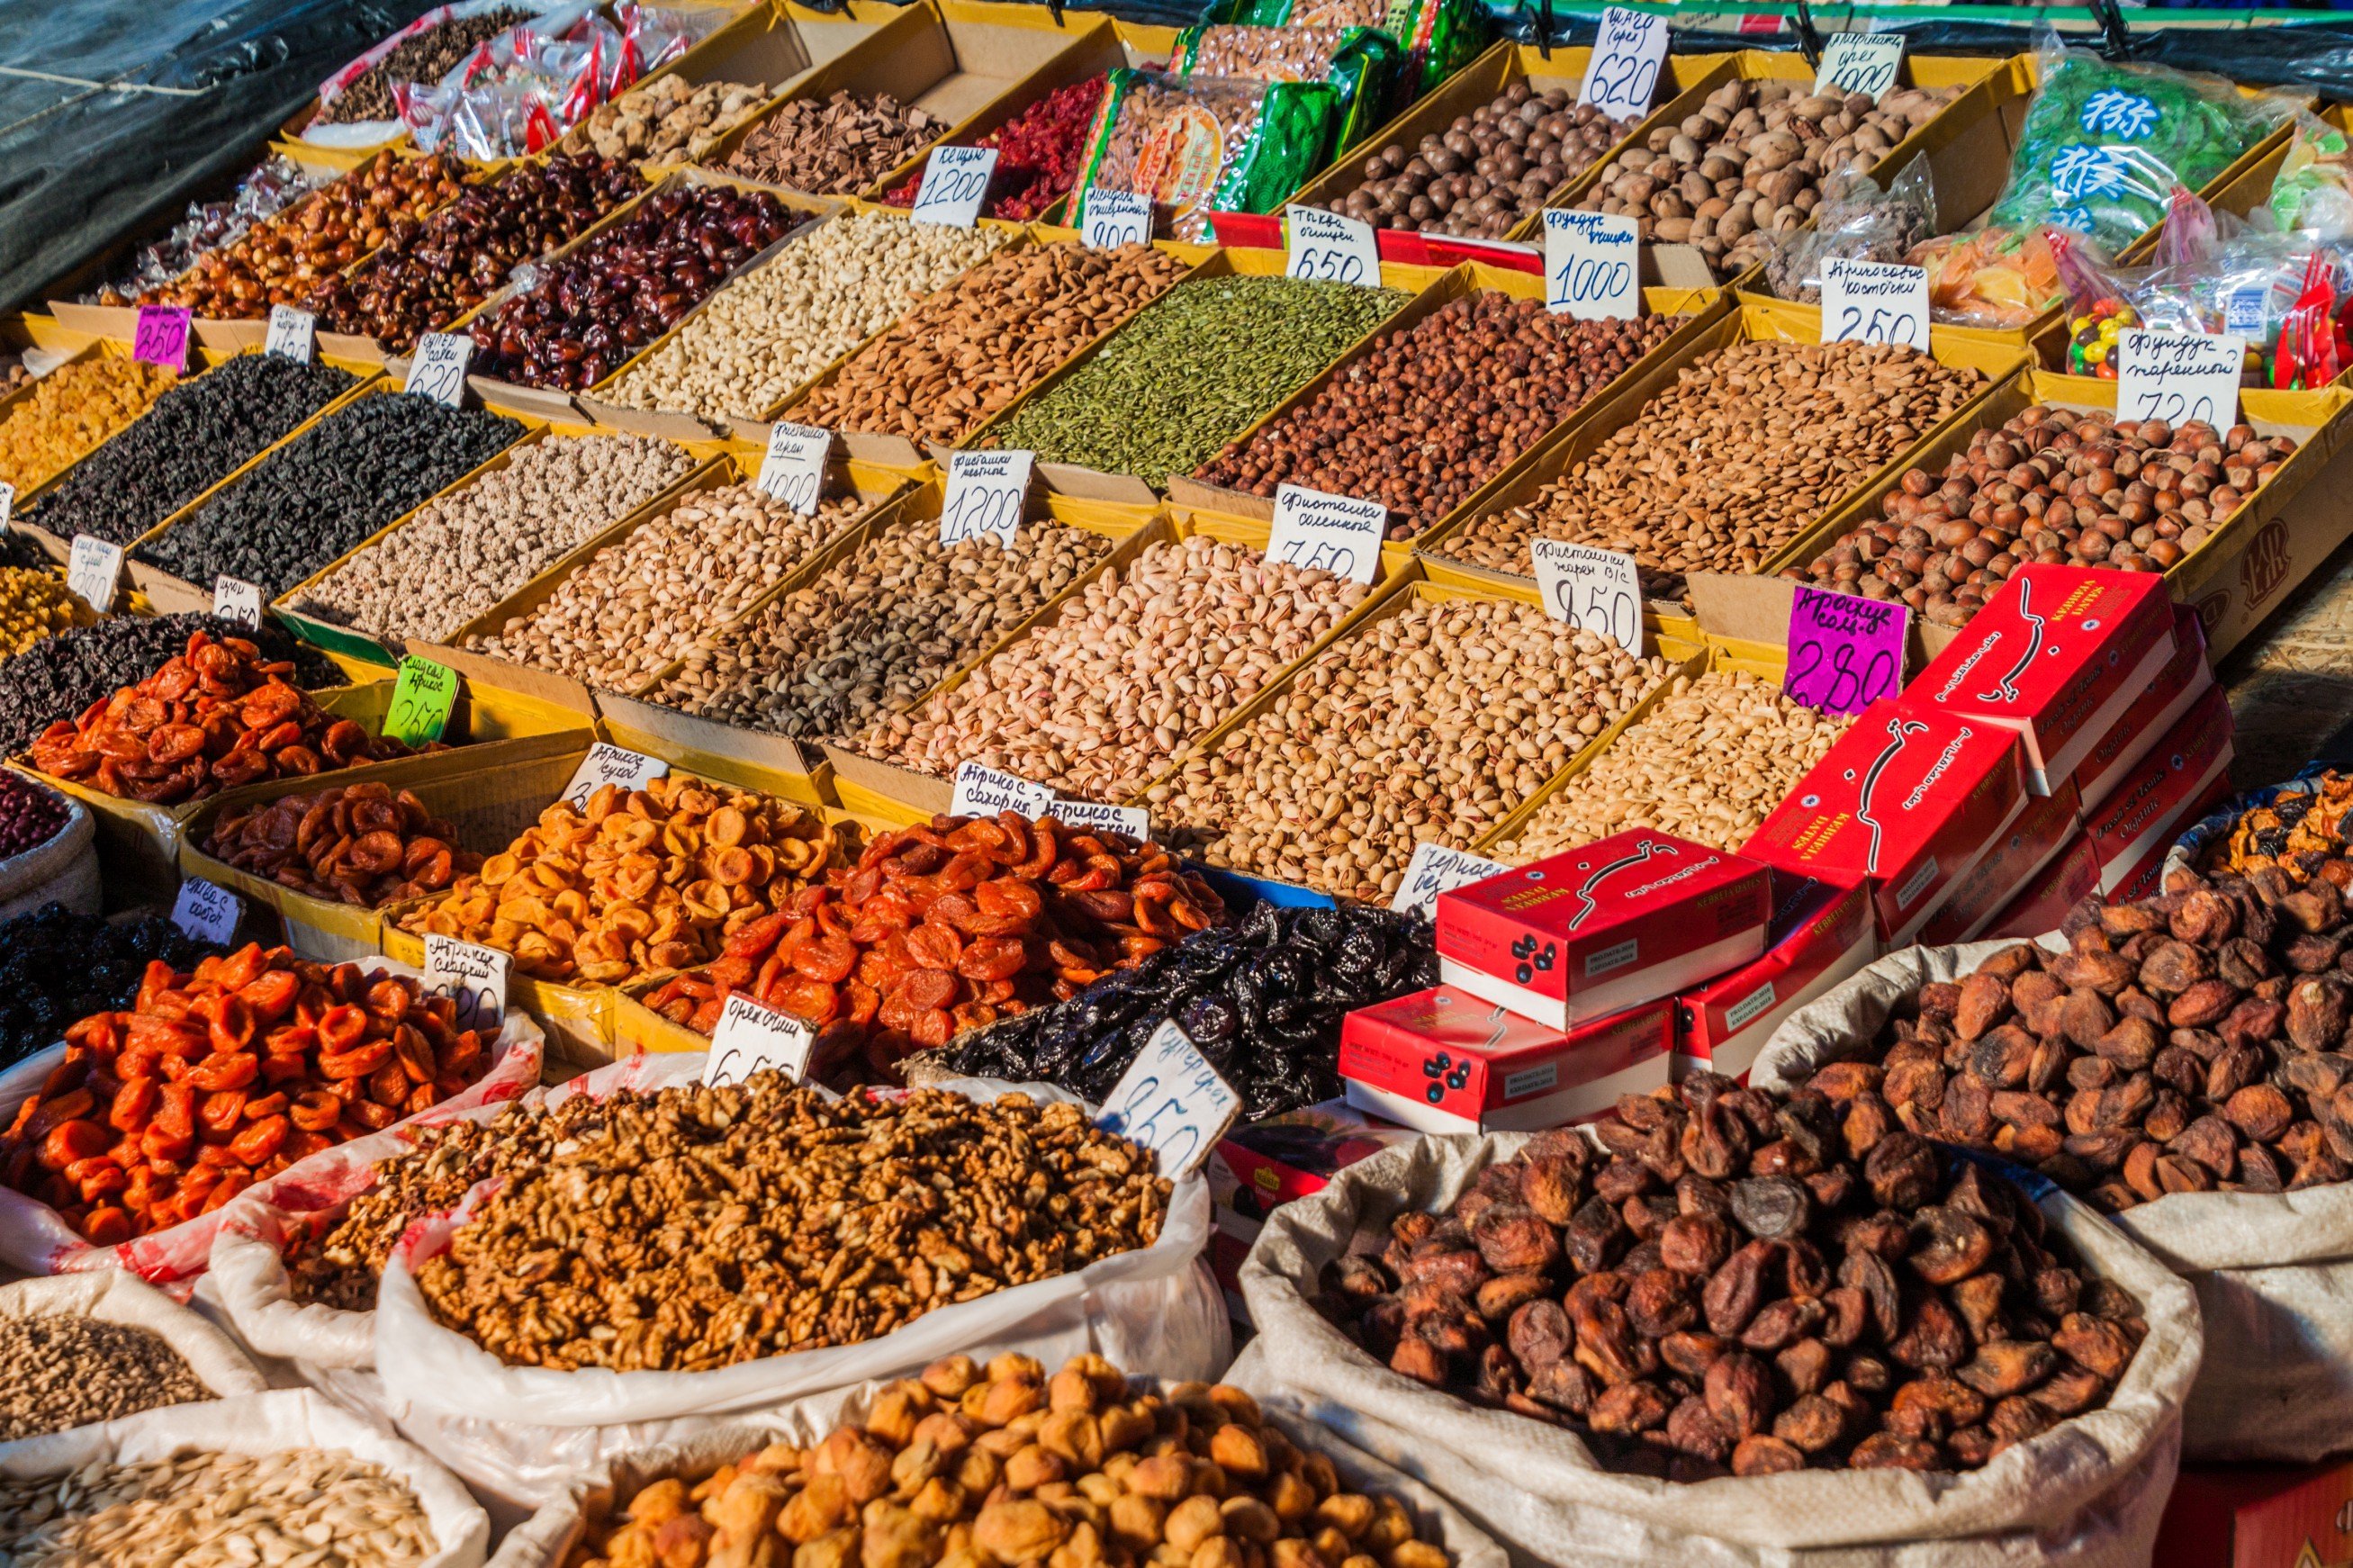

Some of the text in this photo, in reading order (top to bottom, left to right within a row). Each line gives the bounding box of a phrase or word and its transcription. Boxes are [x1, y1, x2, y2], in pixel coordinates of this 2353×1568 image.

[1590, 53, 1656, 106] 620
[915, 168, 986, 210] 1200
[1296, 248, 1363, 283] 650
[1550, 254, 1630, 305] 1000
[136, 322, 182, 359] 350
[1836, 306, 1916, 345] 250
[410, 364, 459, 401] 620
[2138, 392, 2213, 424] 720
[762, 470, 816, 509] 1000
[942, 486, 1020, 542] 1200
[1284, 540, 1354, 580] 750
[1556, 580, 1635, 648] 850
[1788, 641, 1894, 711] 280
[1121, 1076, 1199, 1174] 850
